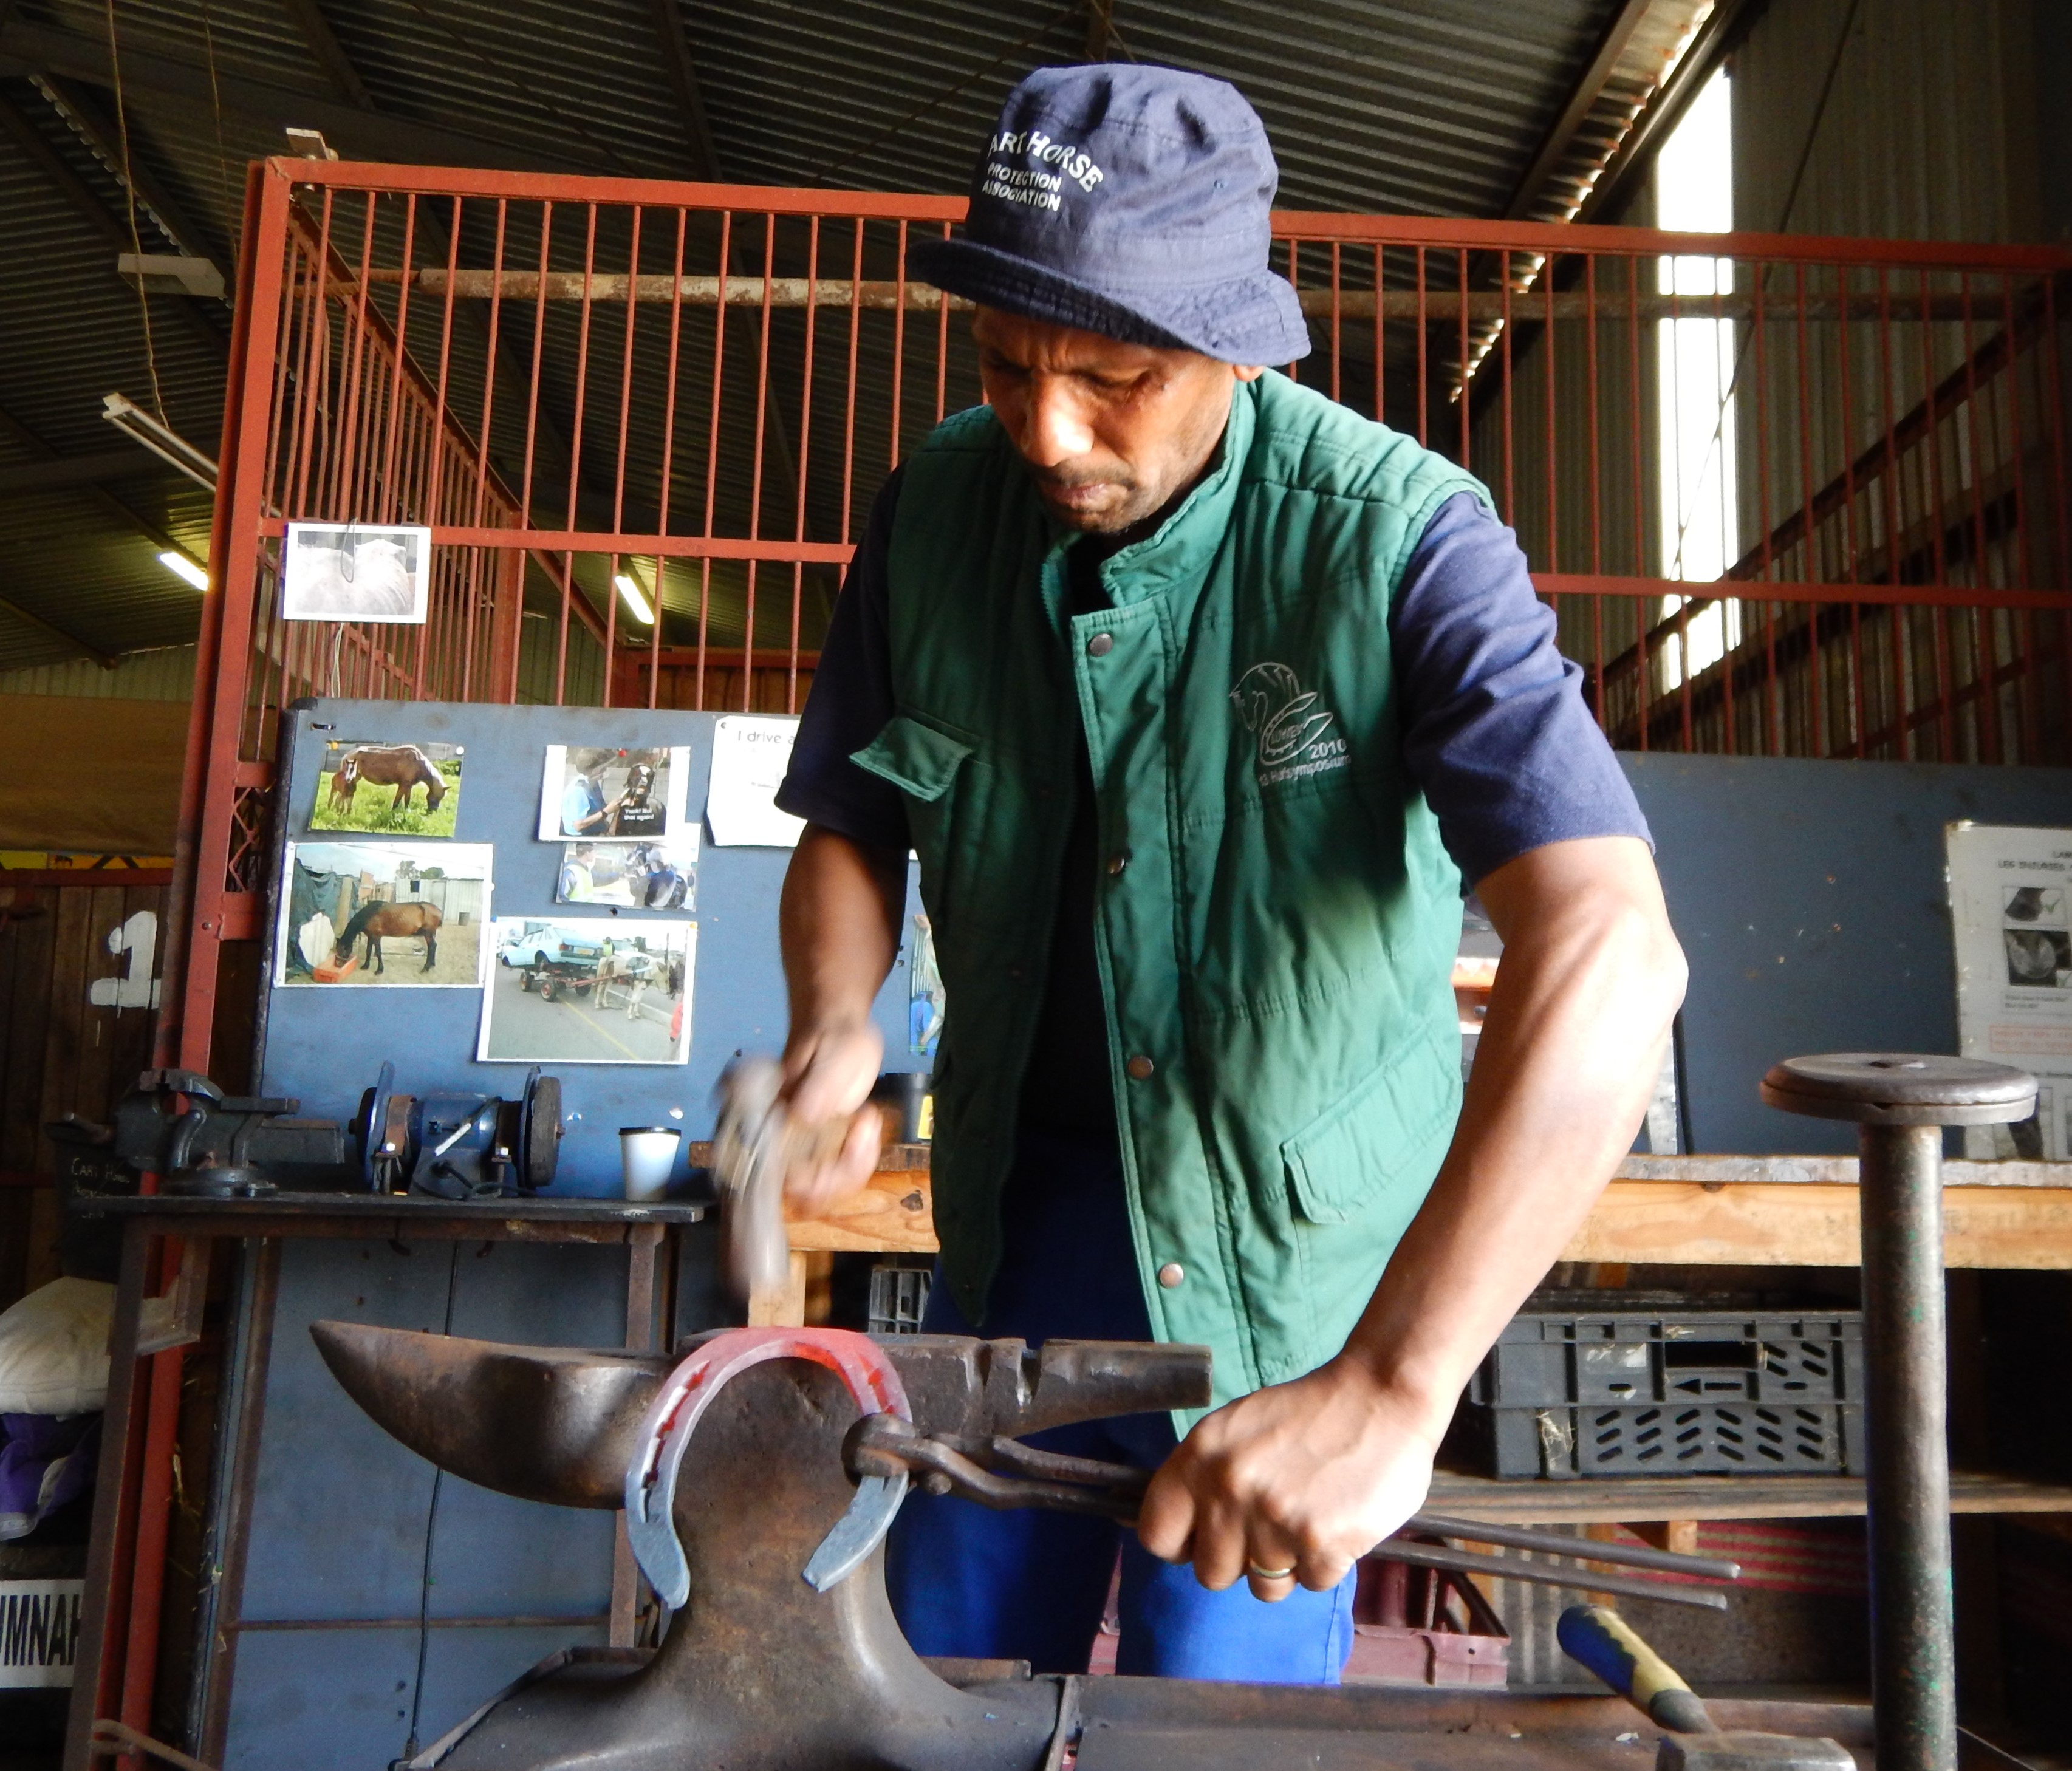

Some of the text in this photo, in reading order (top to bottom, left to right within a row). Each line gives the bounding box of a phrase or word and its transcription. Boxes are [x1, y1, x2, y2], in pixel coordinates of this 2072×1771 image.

[987, 162, 1062, 192] PROTECTION
[1027, 131, 1104, 193] HORSE
[982, 179, 1061, 211] ASSOCIATION
[747, 731, 781, 743] drive
[1308, 738, 1347, 759] 2010
[91, 910, 162, 1011] 1
